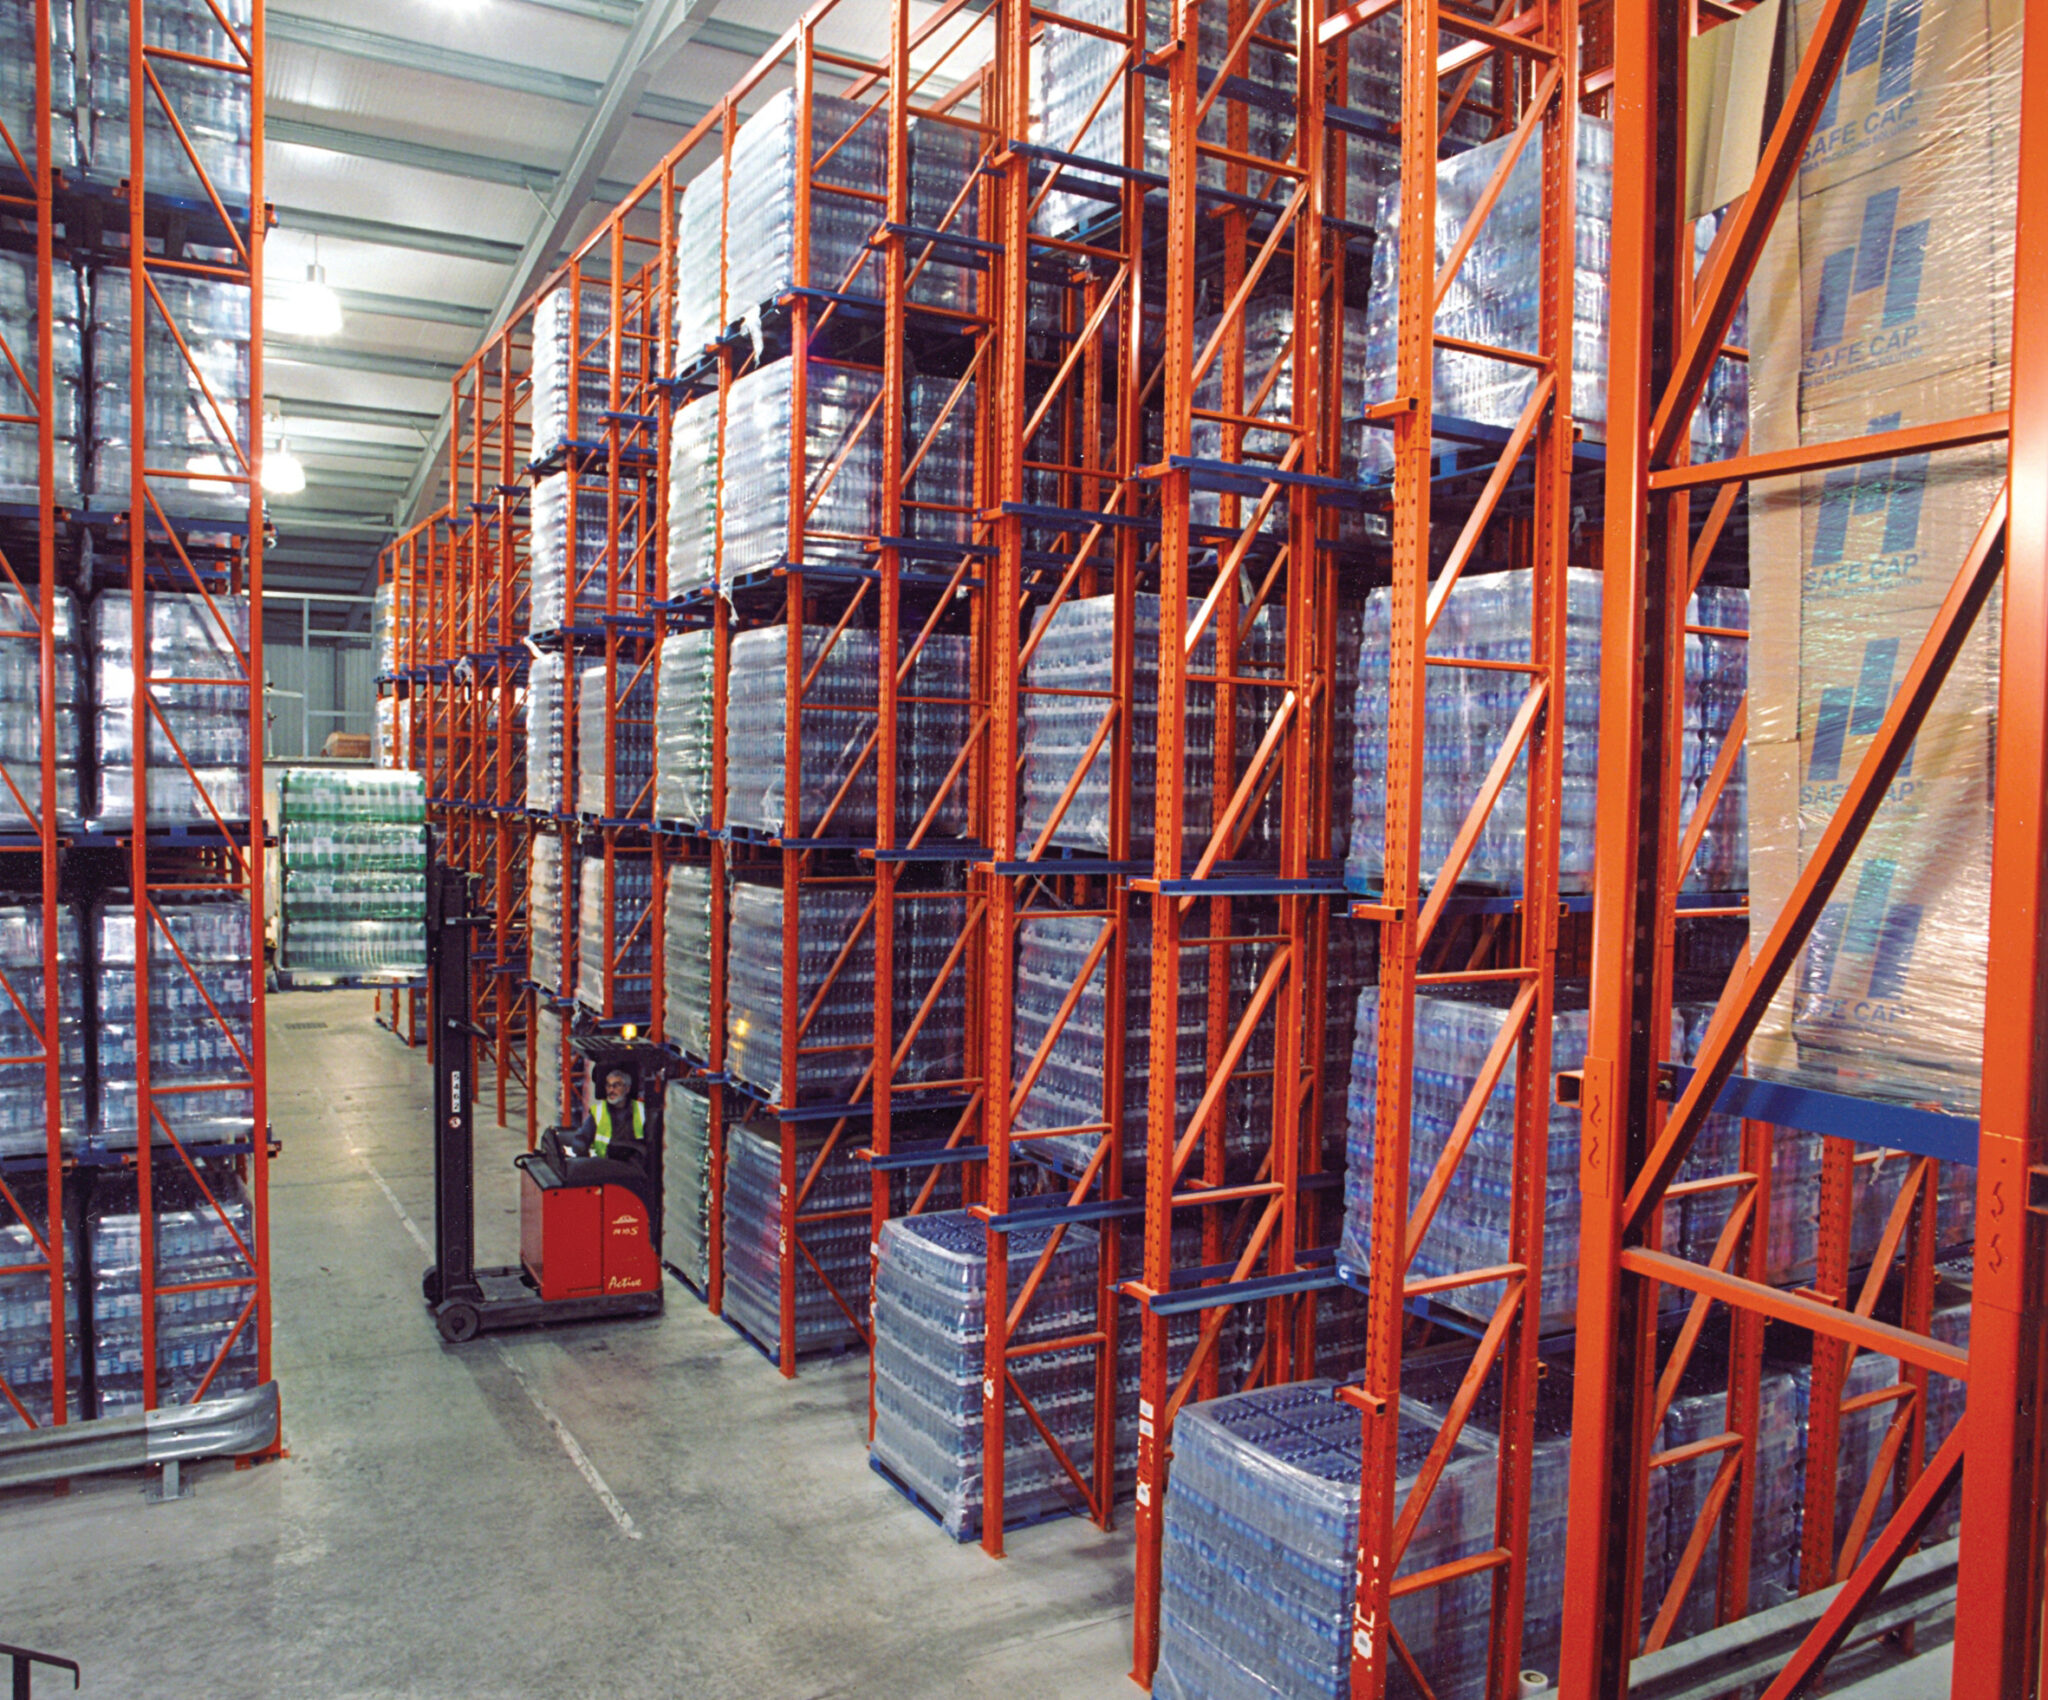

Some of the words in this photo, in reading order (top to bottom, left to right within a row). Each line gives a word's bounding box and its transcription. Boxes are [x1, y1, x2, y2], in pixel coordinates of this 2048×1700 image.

[1800, 119, 1858, 164] SAFE
[1863, 95, 1915, 135] CAP
[1802, 340, 1863, 377] SAFE
[1868, 324, 1919, 356] CAP
[1802, 561, 1863, 592] SAFE
[1868, 553, 1919, 581] CAP
[1800, 783, 1850, 805] SAF
[1883, 781, 1915, 803] AP
[608, 1275, 642, 1290] Active
